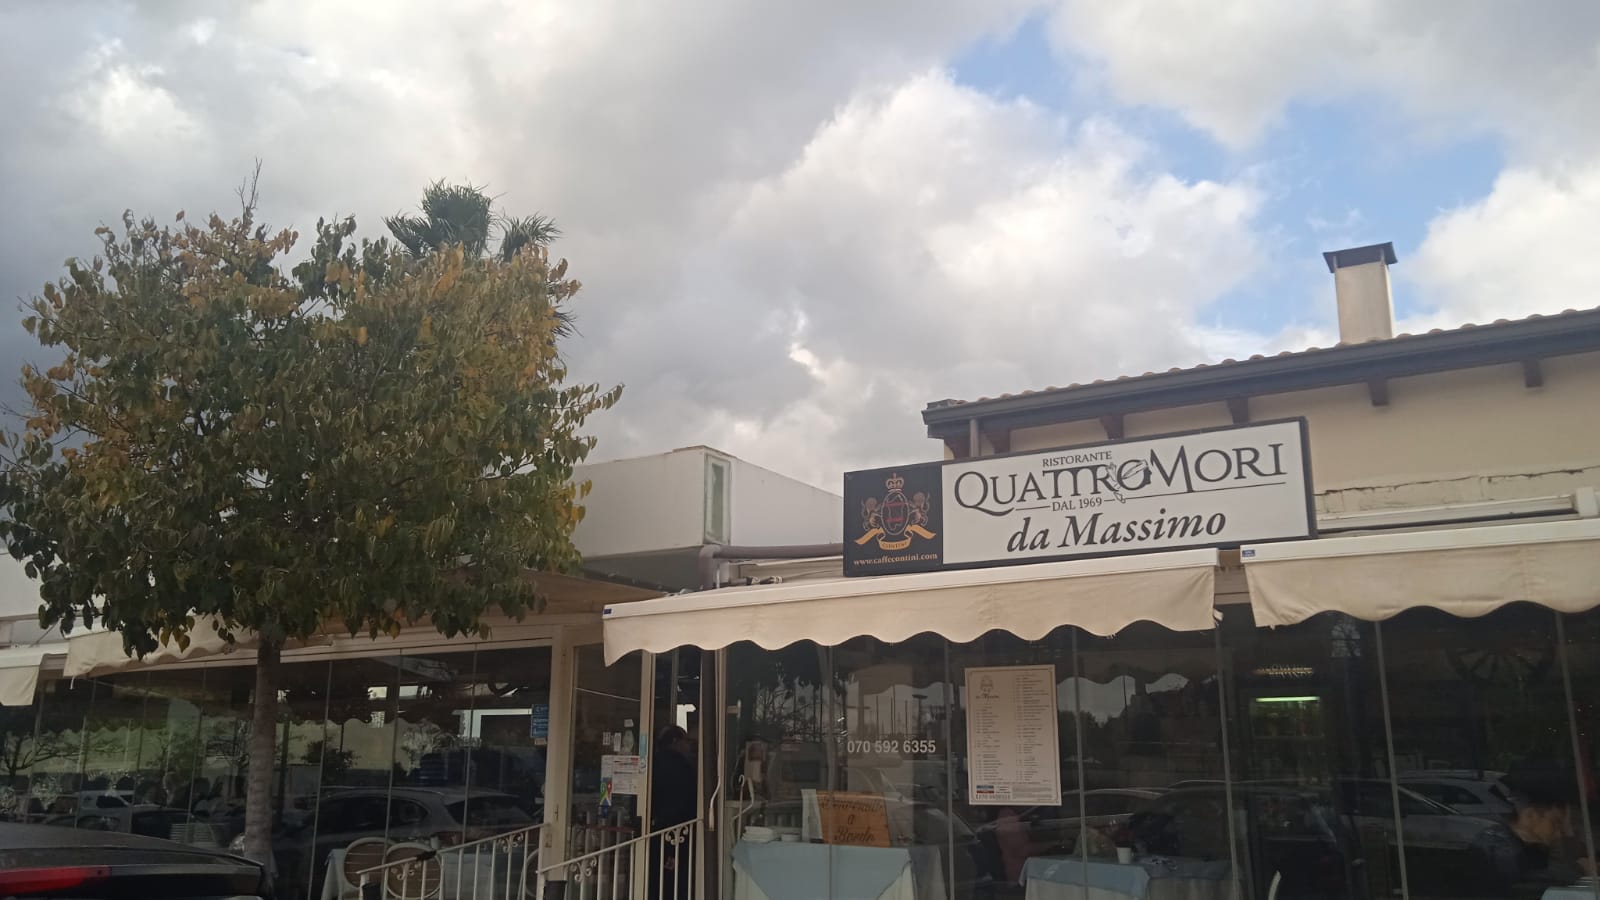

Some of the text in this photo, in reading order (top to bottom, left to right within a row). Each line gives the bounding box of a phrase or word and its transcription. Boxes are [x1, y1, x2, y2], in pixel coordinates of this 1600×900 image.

[1042, 450, 1112, 468] RISTORANTE
[1052, 496, 1102, 511] DAL 1969
[1007, 507, 1226, 552] da Massimo
[847, 740, 936, 753] 070 592 6355
